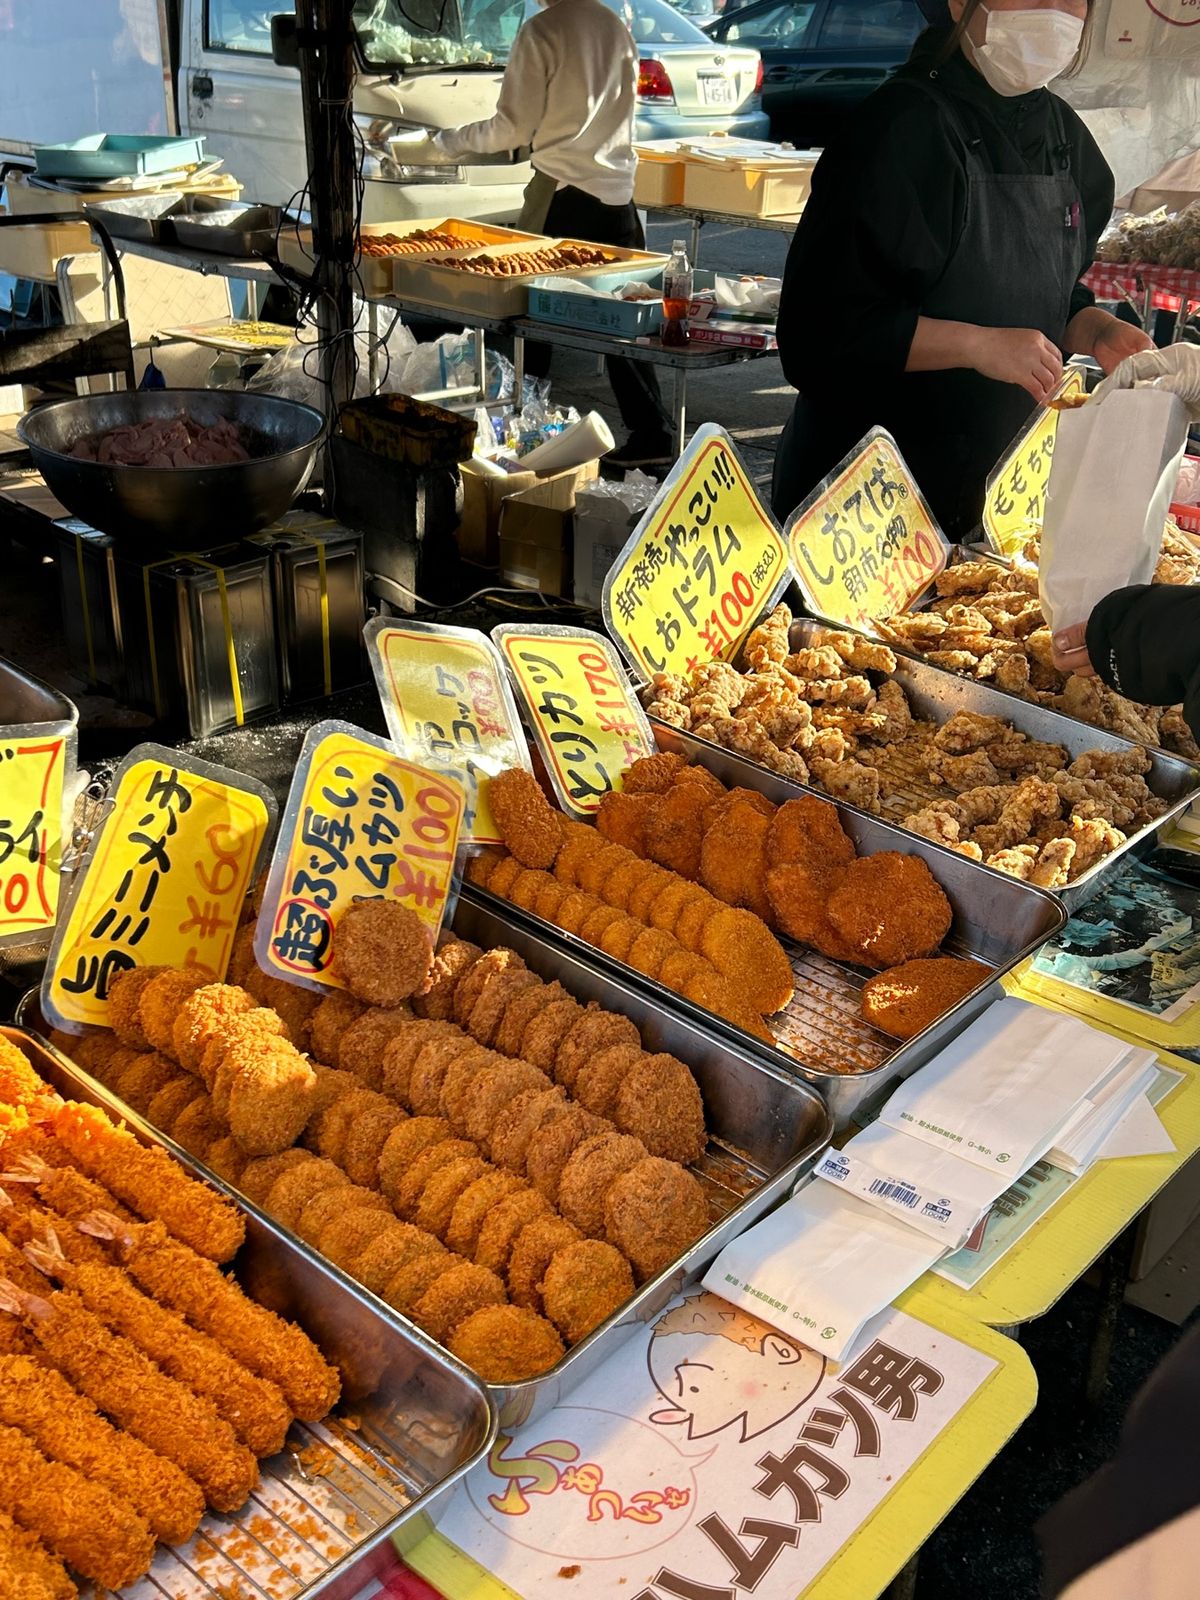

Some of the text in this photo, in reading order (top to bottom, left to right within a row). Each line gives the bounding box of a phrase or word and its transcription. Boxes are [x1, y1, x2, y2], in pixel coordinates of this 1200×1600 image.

[614, 541, 668, 626] 新発売
[642, 524, 742, 672] しおドラム
[697, 570, 755, 659] ¥100
[750, 544, 778, 590] (税込)
[841, 514, 908, 602] 朝市名物
[877, 530, 937, 609] ¥100
[518, 651, 613, 799] とりカツ
[578, 652, 637, 737] ¥170
[60, 768, 192, 1001] 旨ミニメンチ
[179, 823, 245, 938] ¥60
[273, 765, 359, 971] 超ぶ厚い
[352, 772, 404, 902] ムカツ
[393, 786, 458, 909] ¥100
